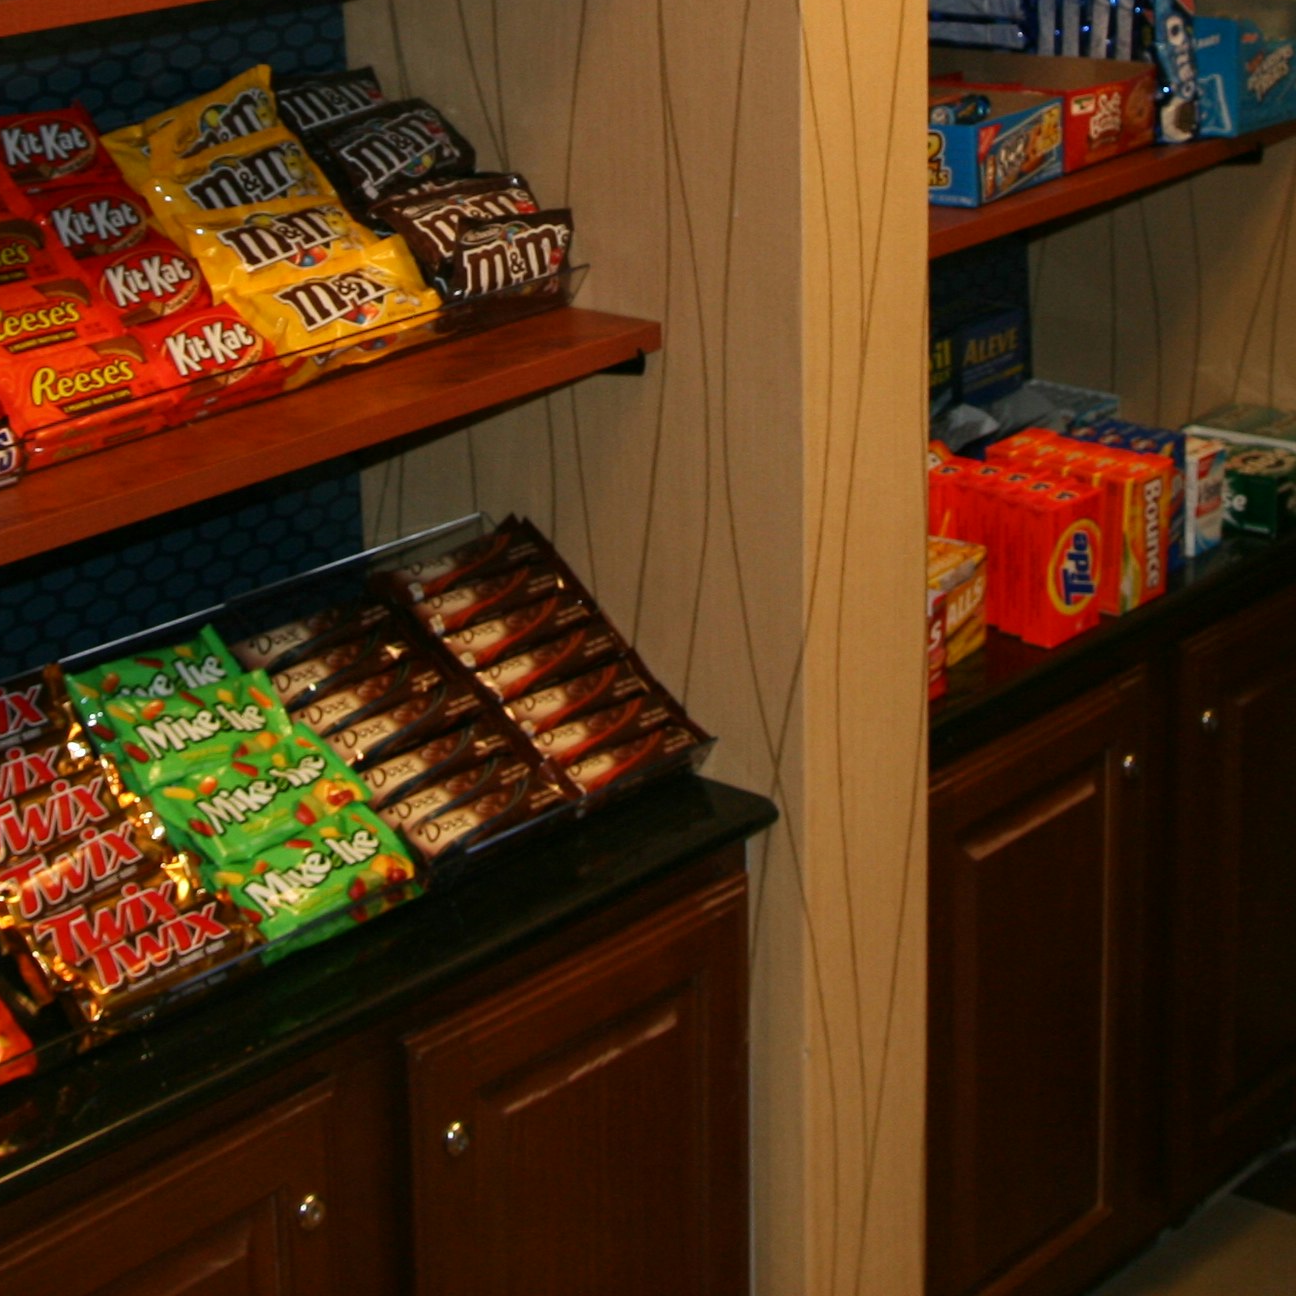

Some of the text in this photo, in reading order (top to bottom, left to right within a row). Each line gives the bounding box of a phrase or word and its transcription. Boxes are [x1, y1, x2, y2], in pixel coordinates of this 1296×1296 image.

[961, 326, 1020, 367] ALEVE
[31, 359, 135, 406] Reese's
[1142, 478, 1163, 588] Bounce
[1061, 532, 1096, 606] Tide
[945, 576, 984, 634] ALLS
[136, 707, 221, 760] Mike
[196, 777, 279, 835] Mike
[242, 850, 332, 917] Mike
[33, 880, 182, 966] Twix
[86, 902, 231, 995] Twix
